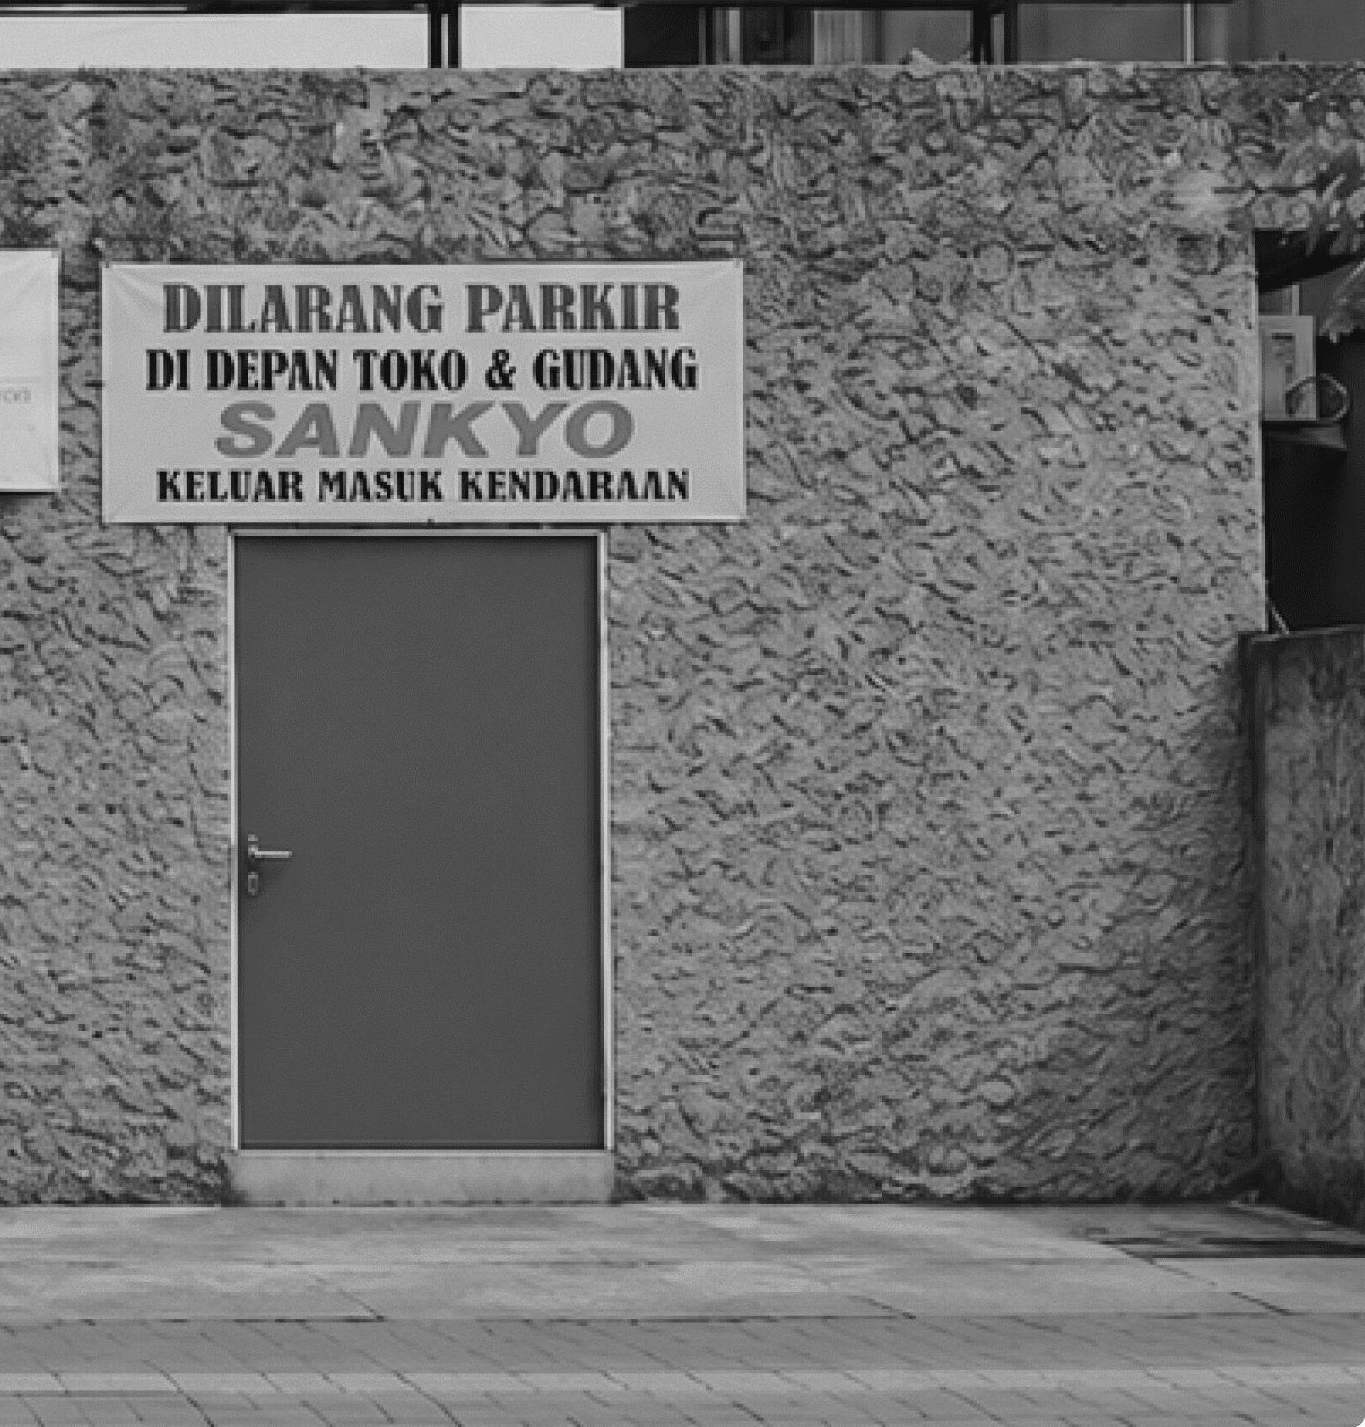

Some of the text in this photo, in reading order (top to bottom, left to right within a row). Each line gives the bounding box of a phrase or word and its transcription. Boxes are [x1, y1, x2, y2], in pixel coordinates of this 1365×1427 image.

[162, 282, 681, 334] DILARANG PARKIR
[145, 346, 699, 391] DI DEPAN TOKO & GUDANG
[213, 399, 636, 459] SANKYO
[156, 469, 690, 503] KELUAR MASUK KENDARAAN
